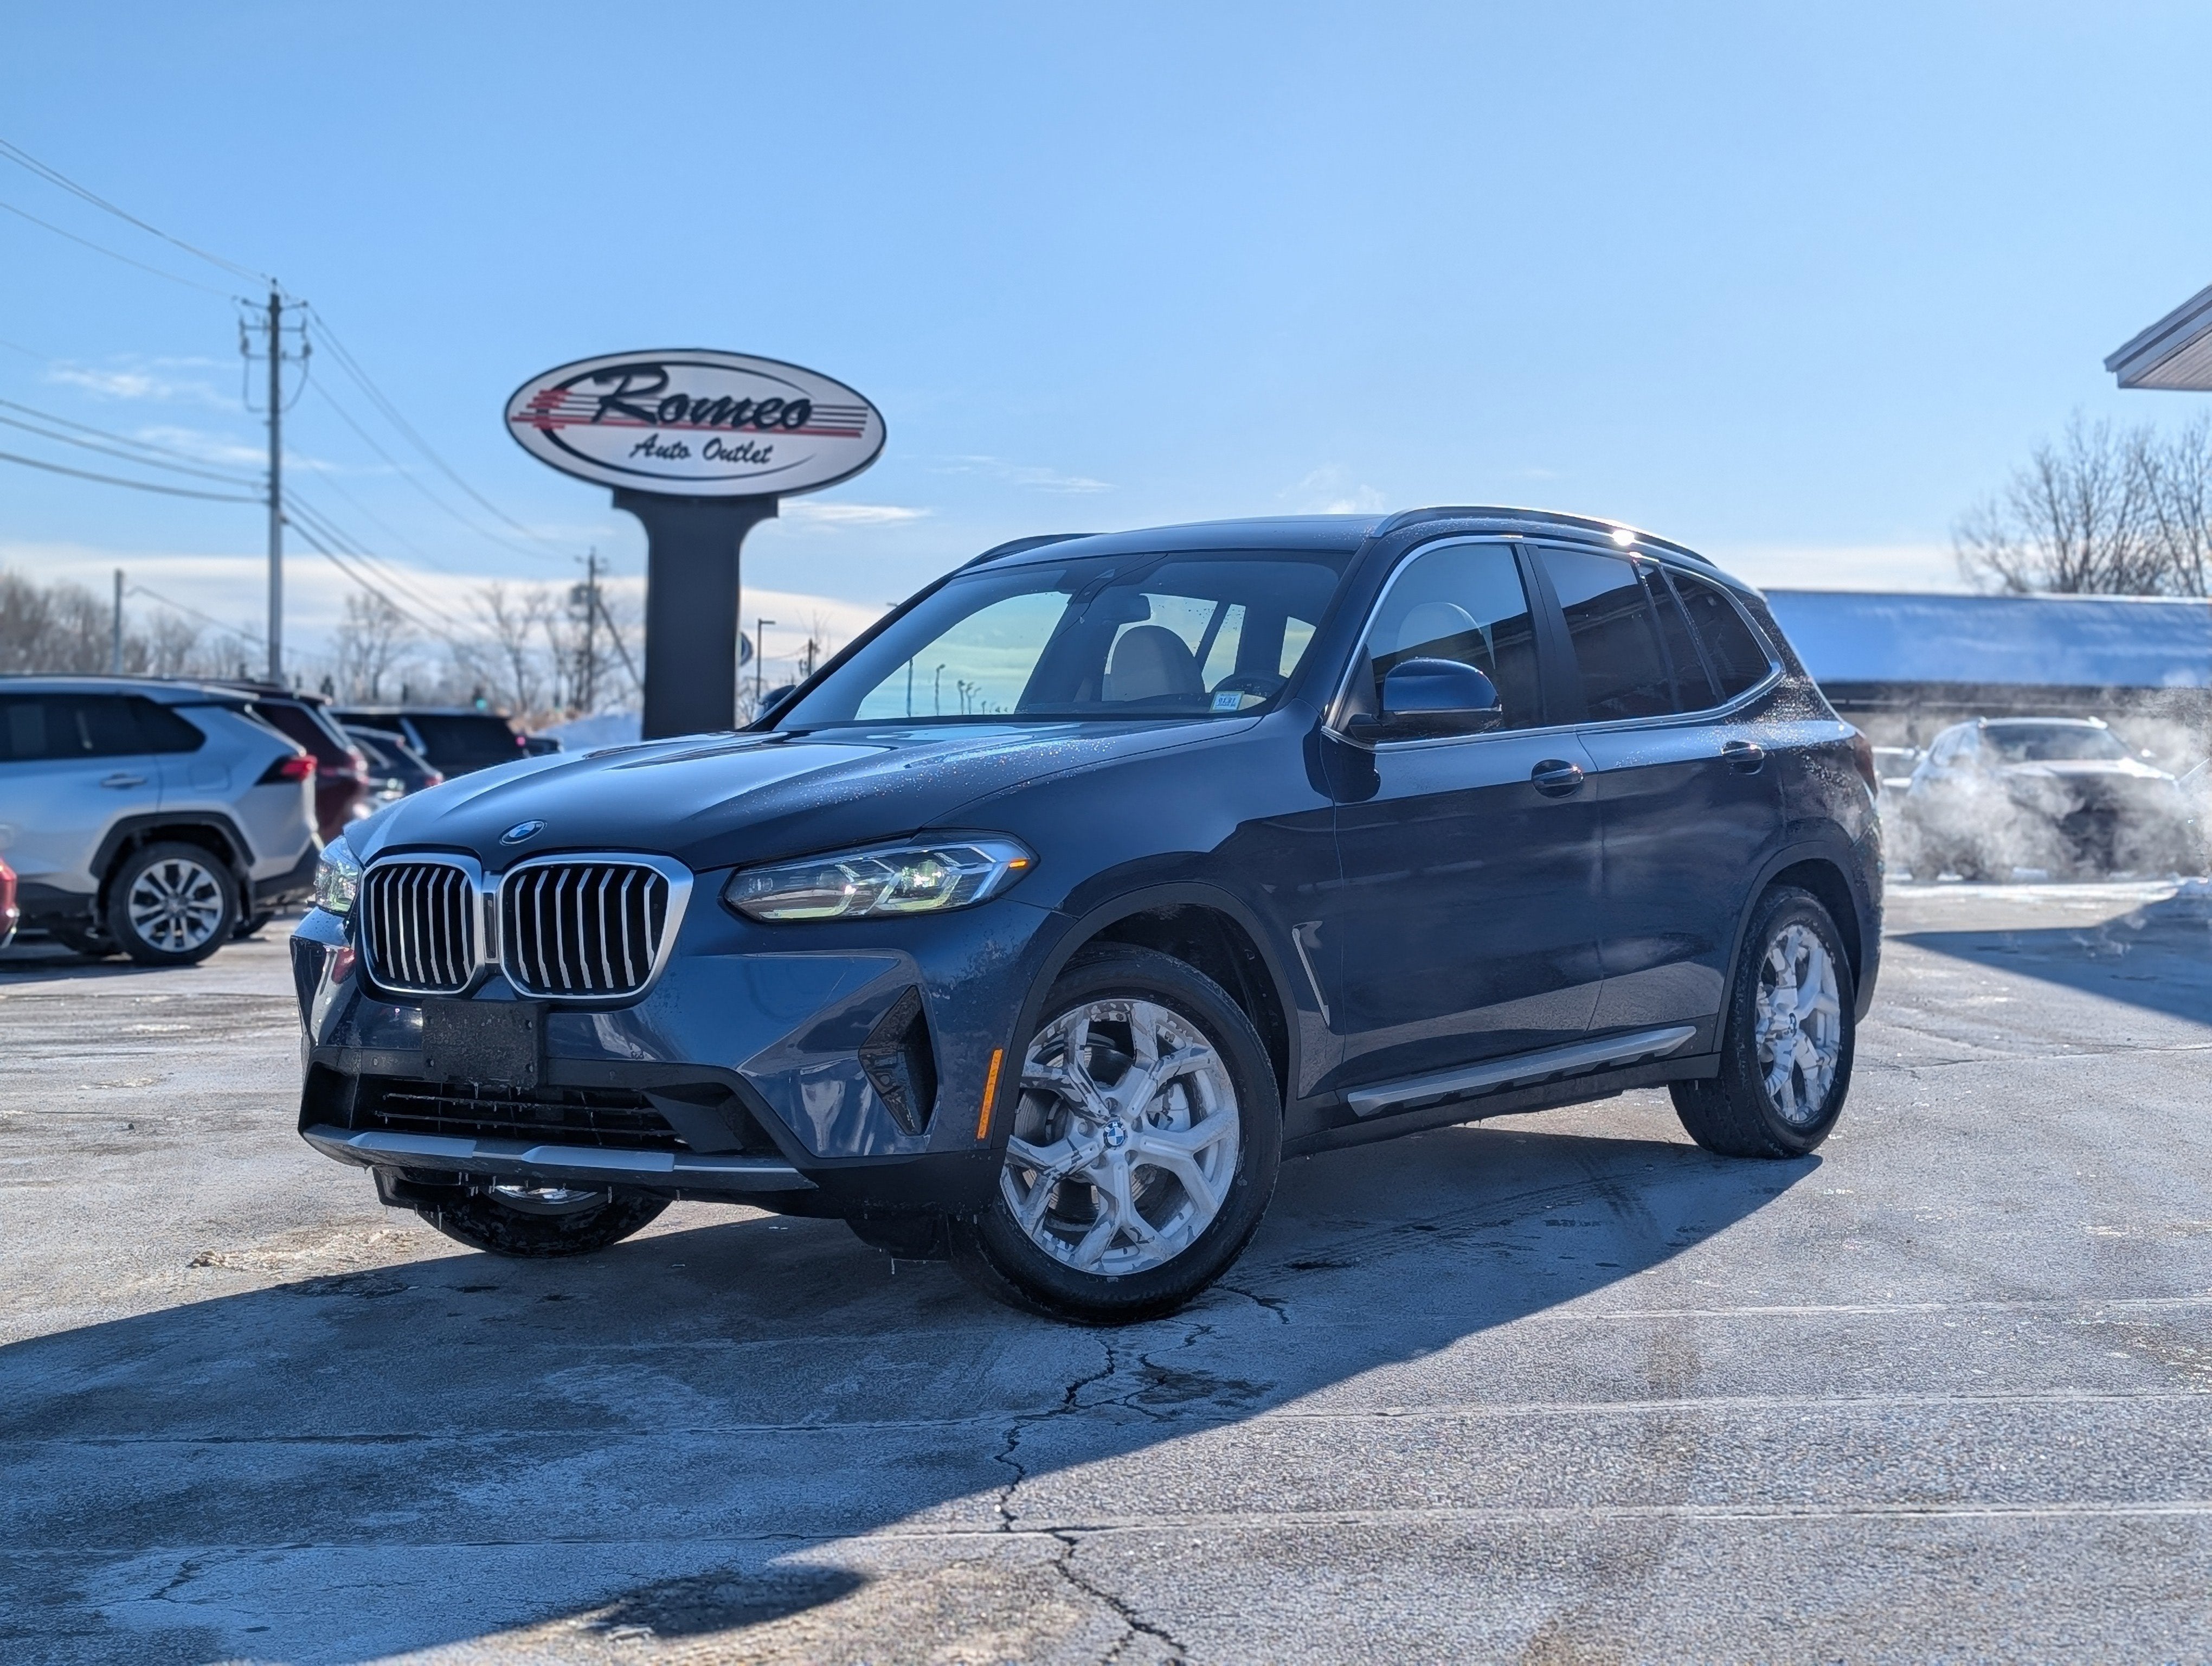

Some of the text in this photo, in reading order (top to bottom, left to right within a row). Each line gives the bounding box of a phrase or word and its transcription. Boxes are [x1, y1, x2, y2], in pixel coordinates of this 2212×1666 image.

[591, 365, 813, 430] Romeo
[629, 433, 774, 464] Auto Outlet
